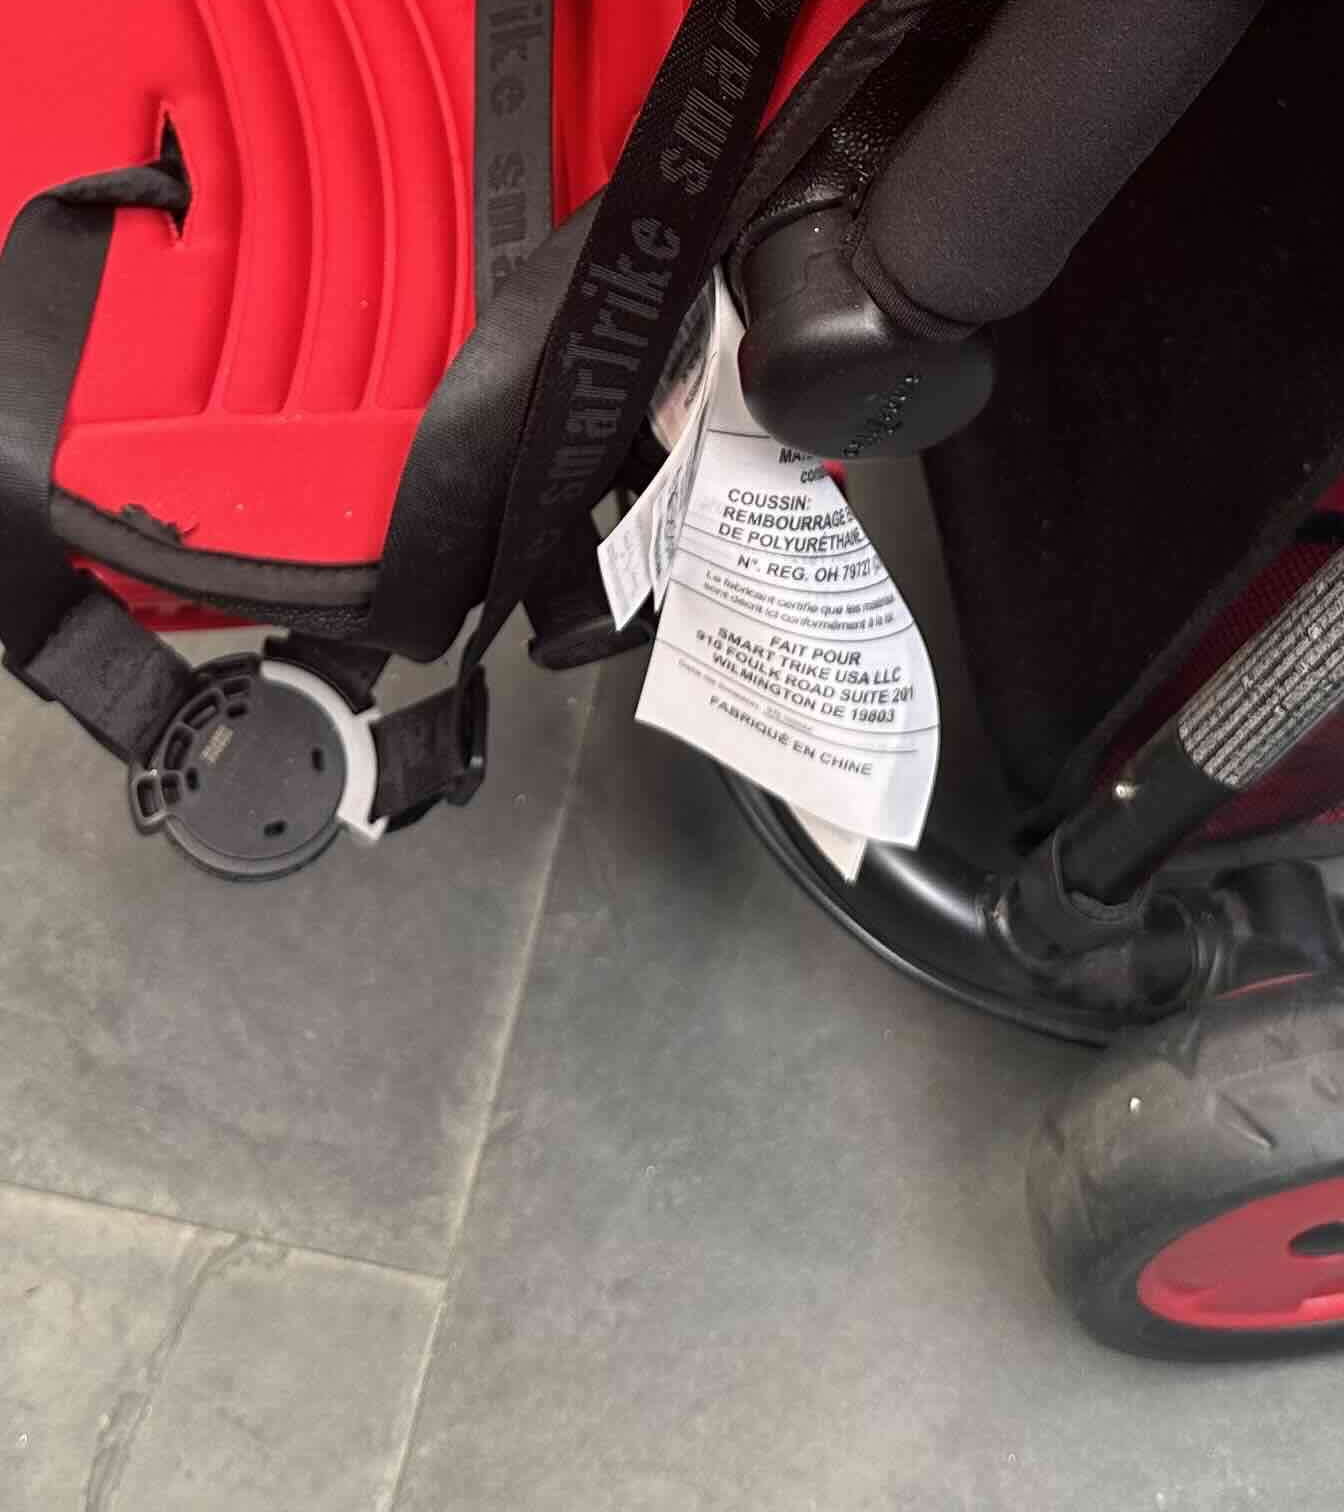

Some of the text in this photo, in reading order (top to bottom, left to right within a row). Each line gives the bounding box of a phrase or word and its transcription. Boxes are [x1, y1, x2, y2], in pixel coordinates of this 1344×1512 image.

[718, 522, 744, 540] DE
[815, 566, 839, 582] OH
[718, 627, 902, 685] SMART TRIKE USA LLC
[769, 635, 862, 666] FAIT POUR
[712, 654, 818, 711] WILMINGTON
[820, 702, 847, 718] DE
[725, 646, 782, 682] FOULK
[785, 674, 836, 699] ROAD
[839, 688, 890, 705] SUITE
[792, 739, 816, 759] EN
[820, 751, 873, 776] CHINE
